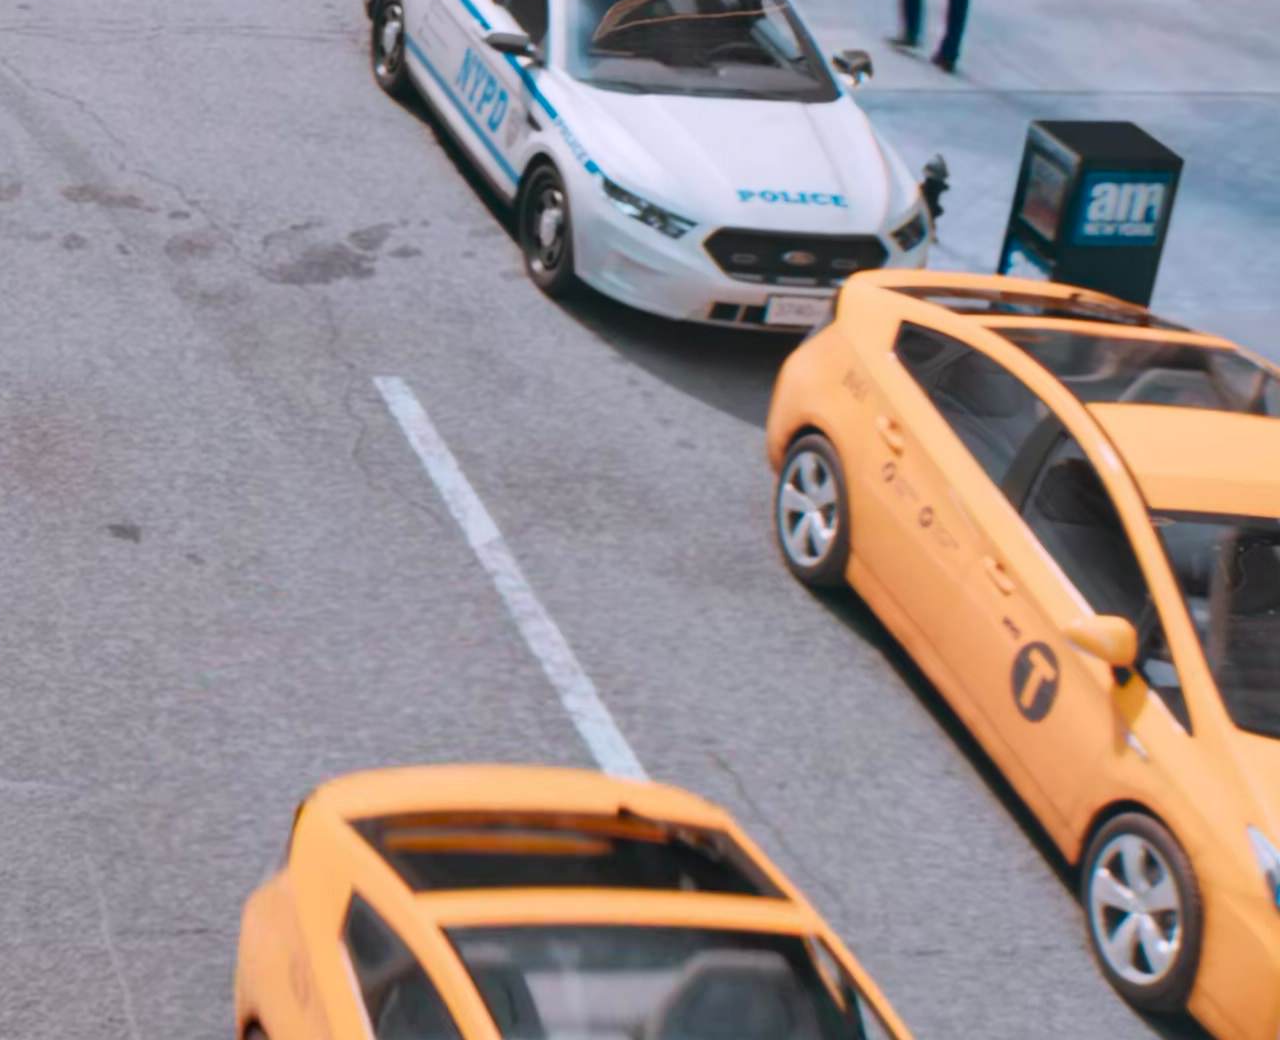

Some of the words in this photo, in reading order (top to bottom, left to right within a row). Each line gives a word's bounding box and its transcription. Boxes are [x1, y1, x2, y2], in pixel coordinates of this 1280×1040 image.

[458, 45, 509, 134] NYPD
[736, 188, 850, 209] POLICE
[1087, 182, 1166, 224] am
[1083, 223, 1116, 236] NEW
[1118, 223, 1155, 237] YORK
[1017, 646, 1057, 710] T
